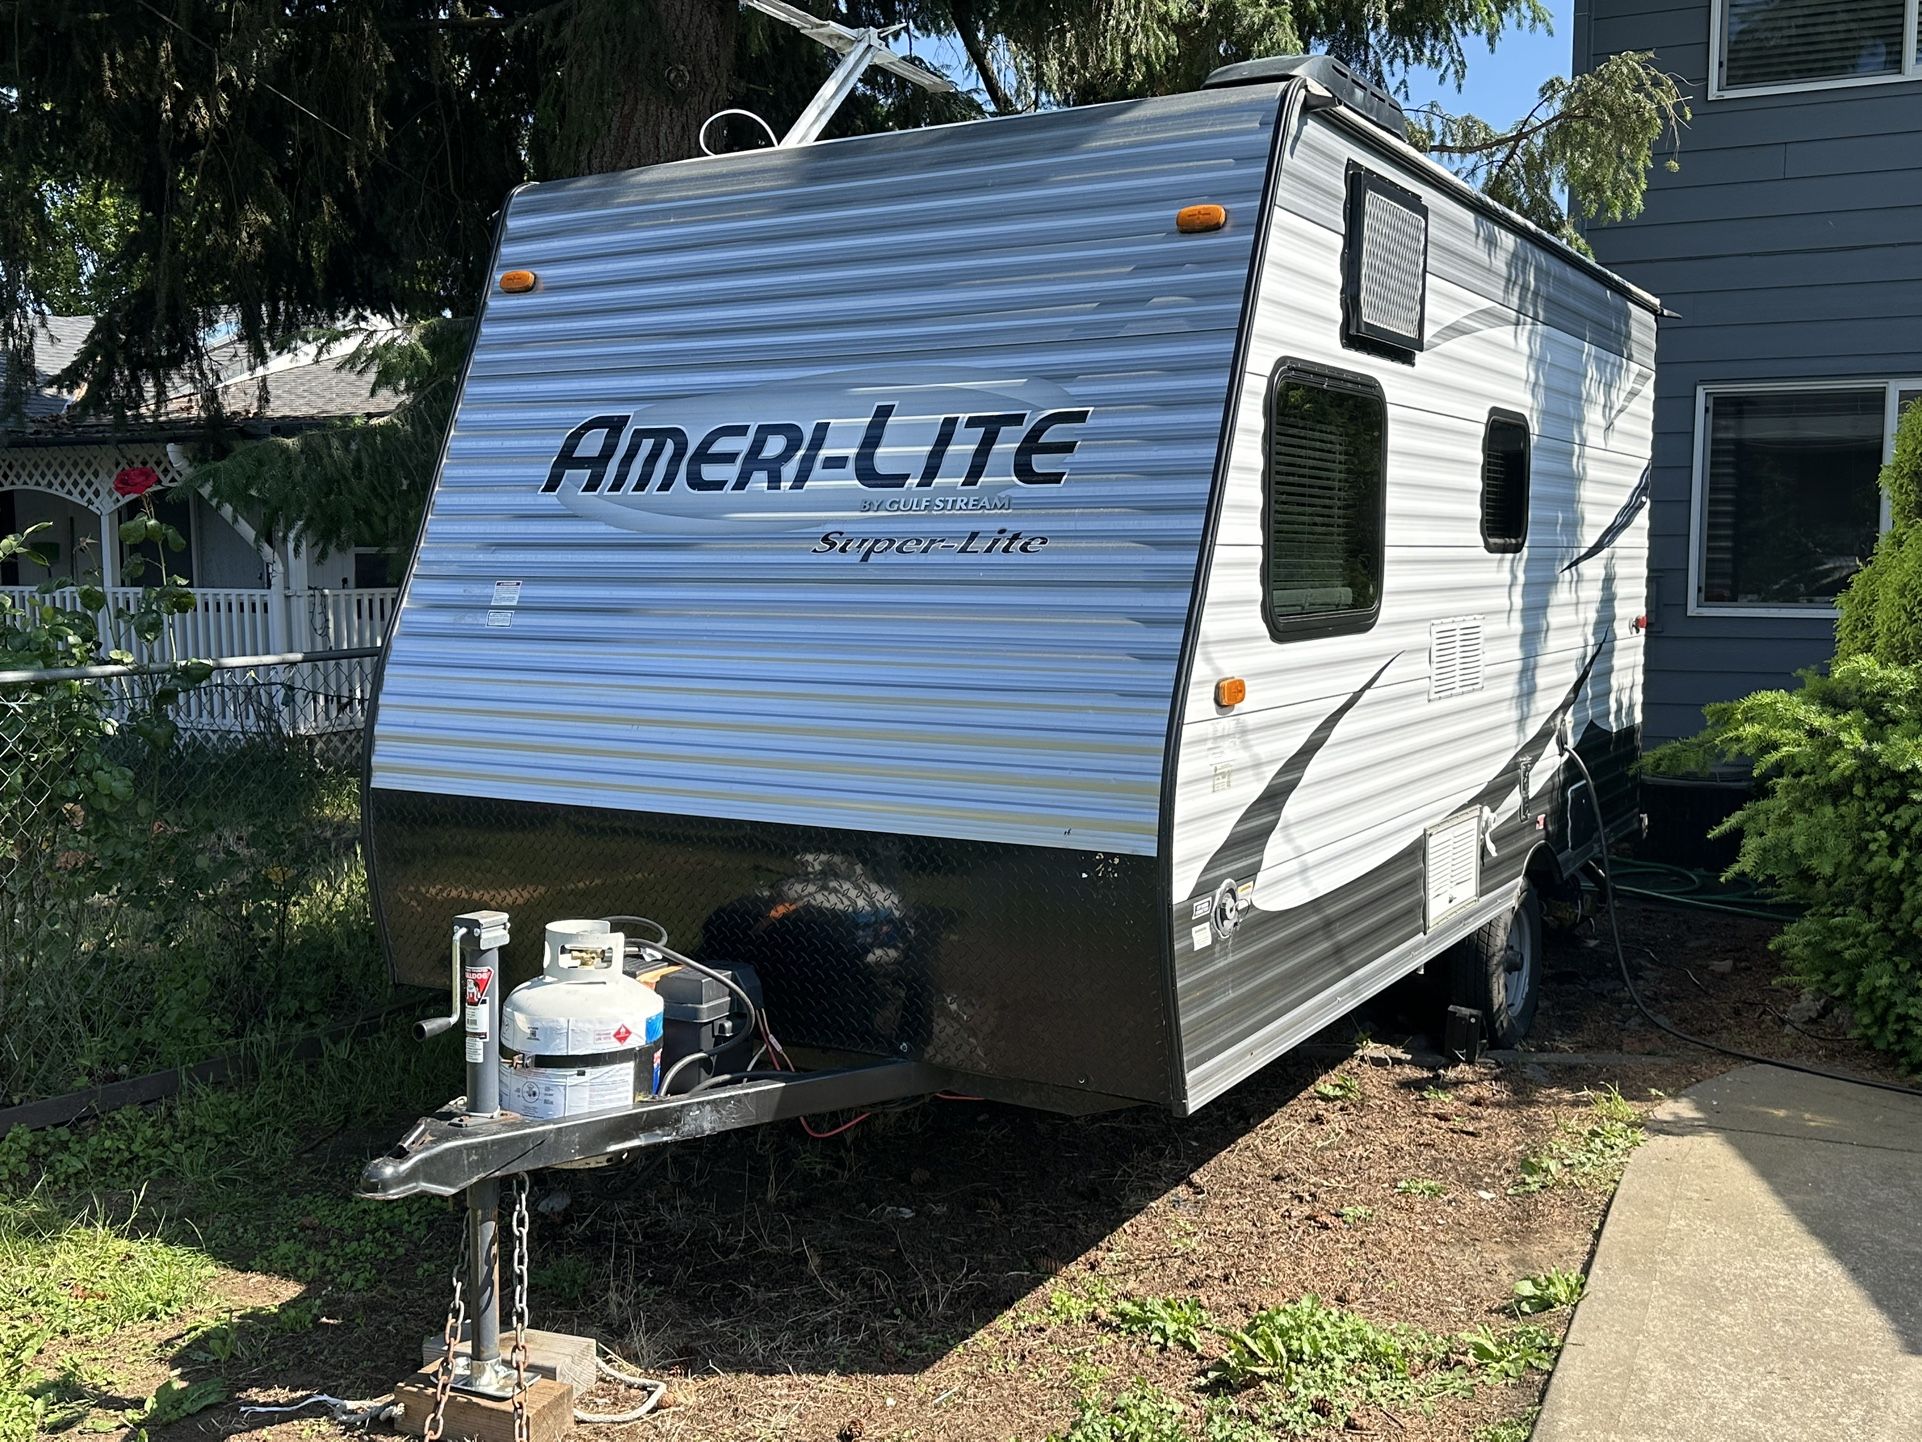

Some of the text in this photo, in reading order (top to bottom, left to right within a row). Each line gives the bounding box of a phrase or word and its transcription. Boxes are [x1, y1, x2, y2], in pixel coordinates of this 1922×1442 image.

[860, 495, 1012, 513] BY GULF STREAM
[811, 528, 1050, 563] Super-Lite
